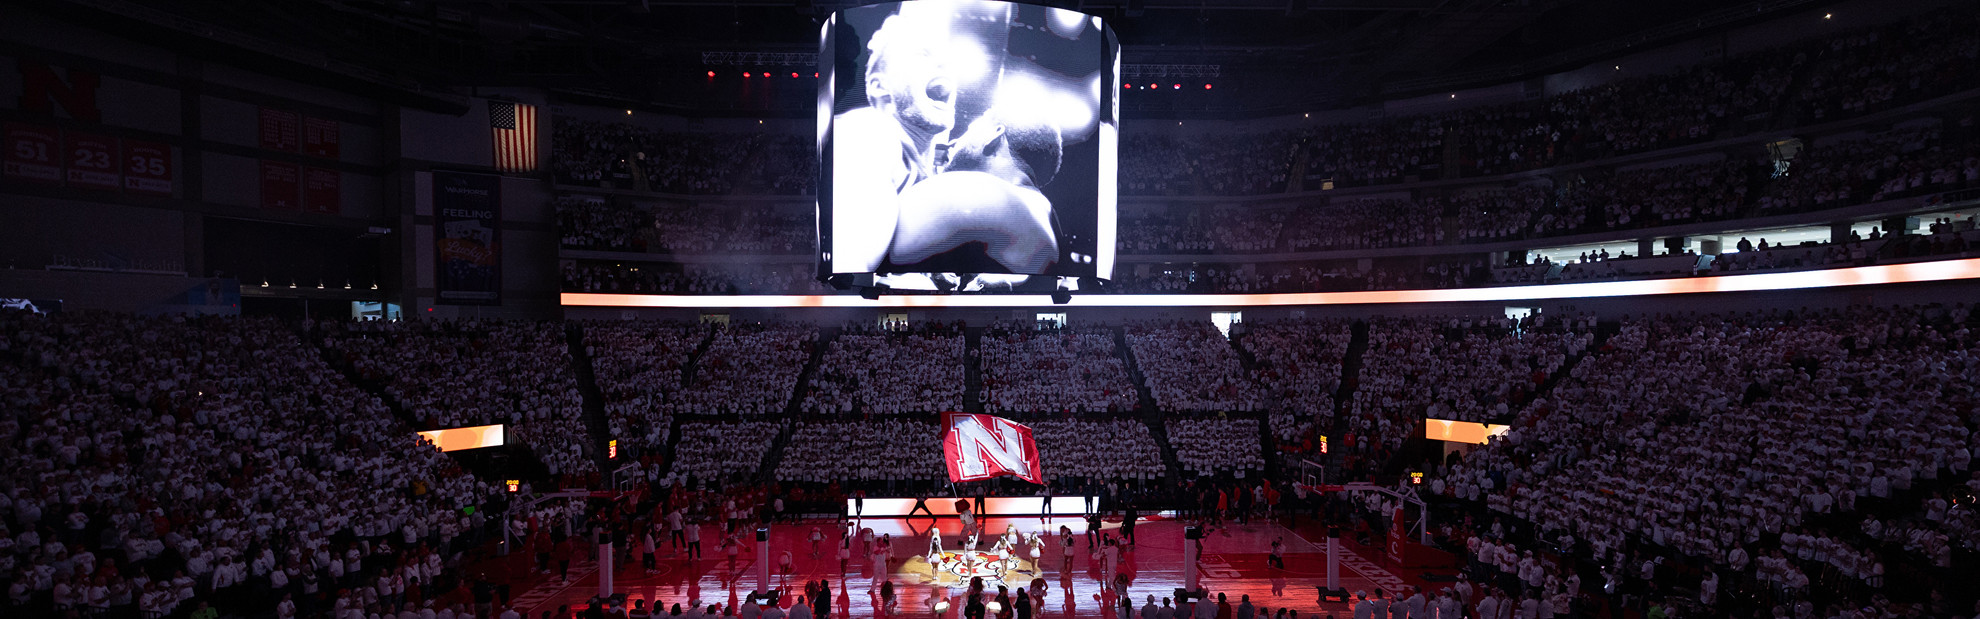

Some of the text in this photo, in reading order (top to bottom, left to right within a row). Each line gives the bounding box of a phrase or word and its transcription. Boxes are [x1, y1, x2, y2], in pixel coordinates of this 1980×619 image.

[19, 57, 102, 121] N
[15, 140, 48, 162] 51
[75, 148, 111, 169] 23
[130, 156, 166, 176] 35
[443, 208, 493, 219] FEELING
[445, 240, 493, 263] Lucky?
[950, 413, 1034, 481] N
[508, 484, 518, 492] 30
